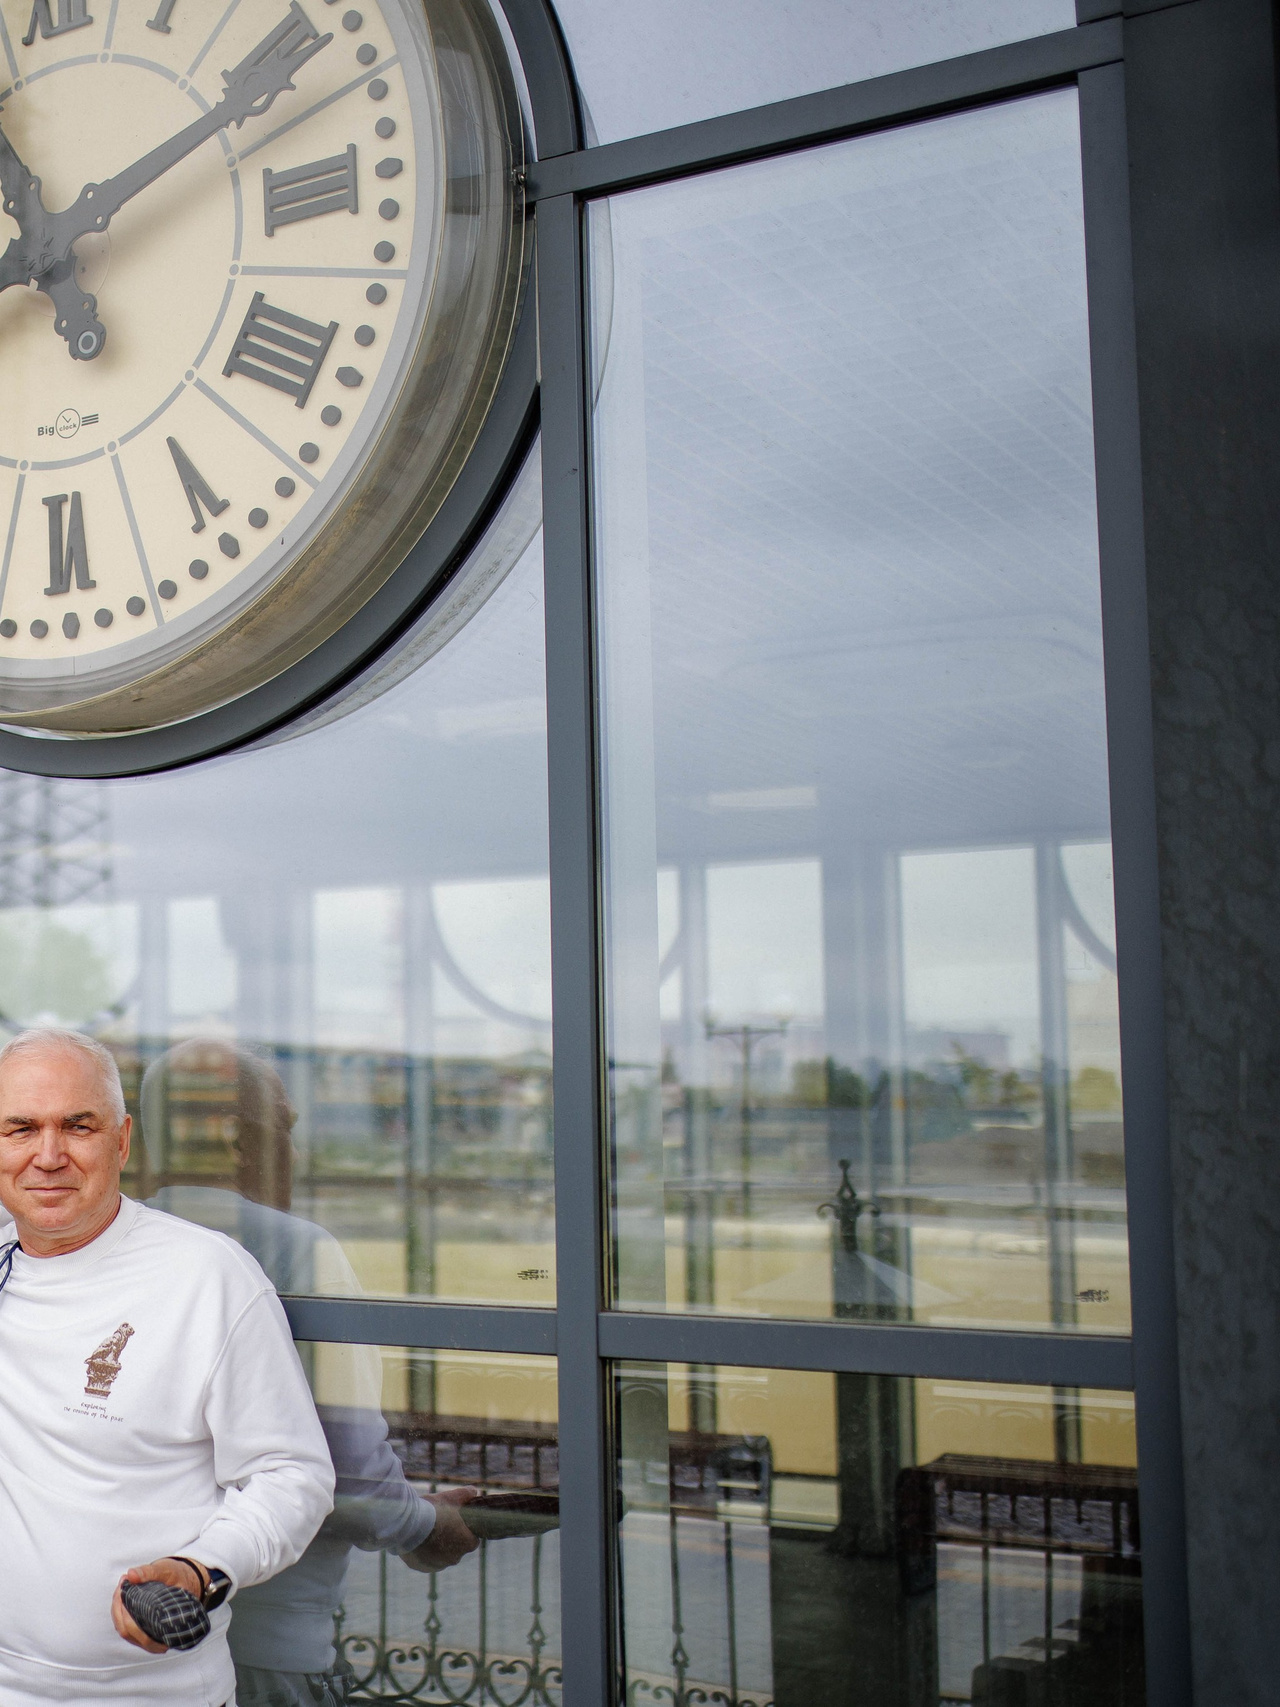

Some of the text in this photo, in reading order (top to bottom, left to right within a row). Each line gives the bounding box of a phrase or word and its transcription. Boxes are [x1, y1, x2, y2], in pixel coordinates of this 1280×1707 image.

[263, 143, 359, 238] III
[222, 291, 339, 409] IIII
[37, 422, 78, 437] Big clock
[166, 436, 231, 534] V
[42, 491, 97, 597] VI
